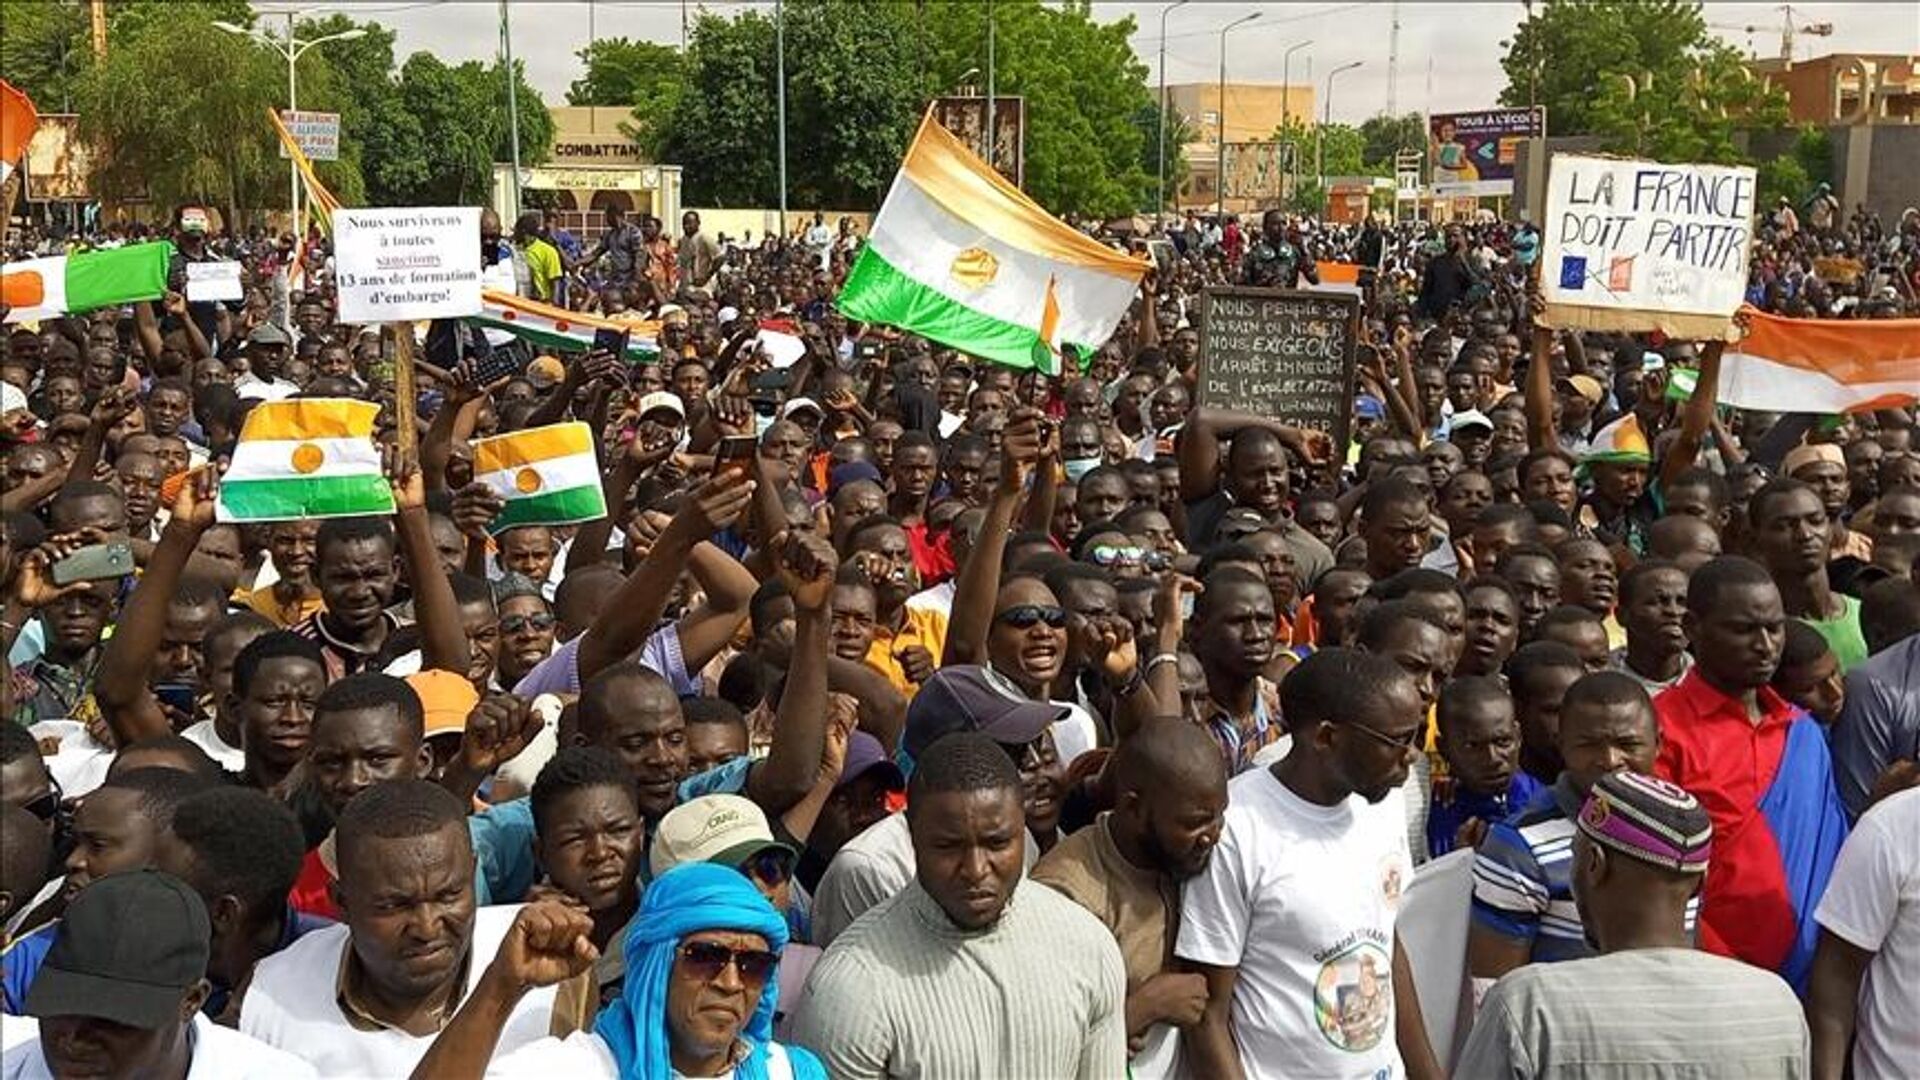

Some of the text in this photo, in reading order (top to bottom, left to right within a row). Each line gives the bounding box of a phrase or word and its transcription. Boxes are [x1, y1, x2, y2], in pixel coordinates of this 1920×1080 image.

[1456, 116, 1484, 126] TOUS
[556, 144, 641, 156] COMBATTAN
[1569, 170, 1752, 220] LA FRANCE
[348, 216, 385, 229] Nous
[380, 234, 435, 247] à toutes
[1645, 218, 1748, 272] PARTIR
[376, 254, 441, 267] sanctions
[340, 269, 477, 287] 13 ans de formation
[369, 288, 451, 304] d'embargo!
[1211, 299, 1254, 316] NOUS
[1209, 380, 1230, 393] DE
[1313, 931, 1357, 963] Général
